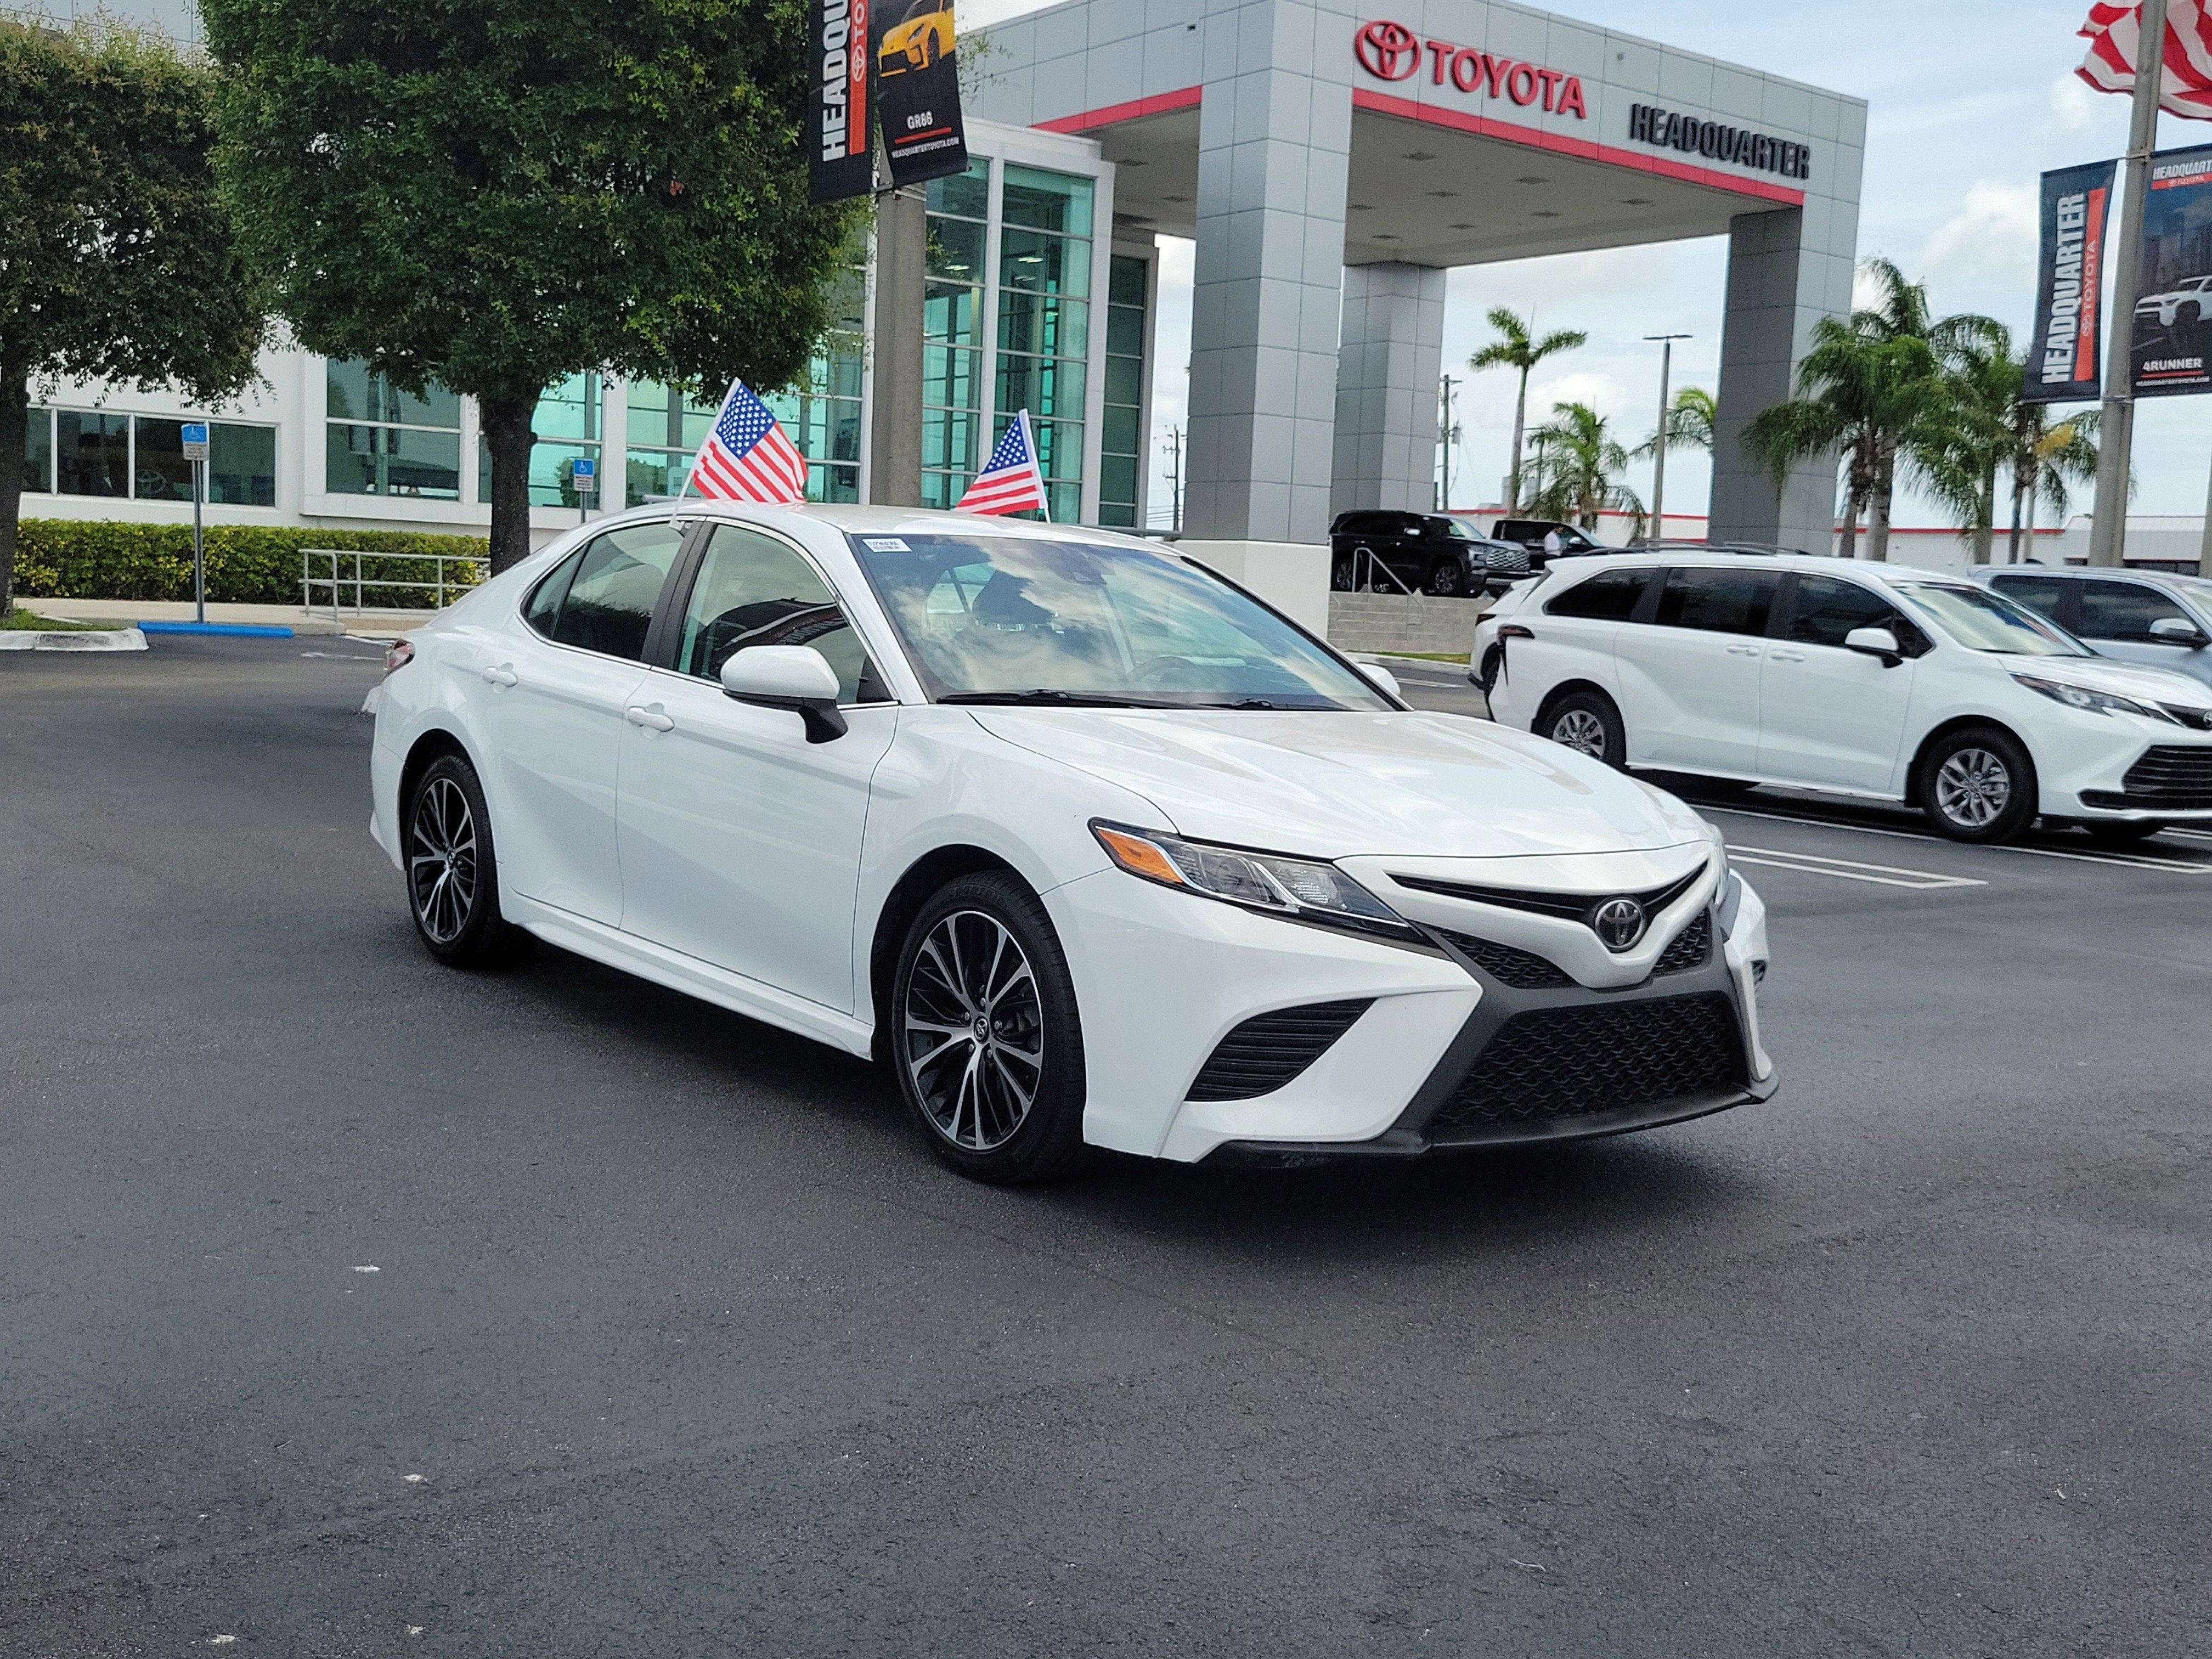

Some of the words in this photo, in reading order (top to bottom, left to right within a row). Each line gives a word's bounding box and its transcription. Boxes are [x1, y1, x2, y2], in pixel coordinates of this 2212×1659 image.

[854, 0, 866, 43] TO
[1427, 40, 1587, 119] TOYOTA
[907, 110, 933, 130] GR86
[1629, 103, 1810, 180] HEADQUARTER
[2153, 159, 2212, 180] HEADQUART
[2041, 192, 2085, 385] HEADQUARTER
[2084, 240, 2096, 315] TOYOTA
[2142, 357, 2202, 371] 4RUNNER
